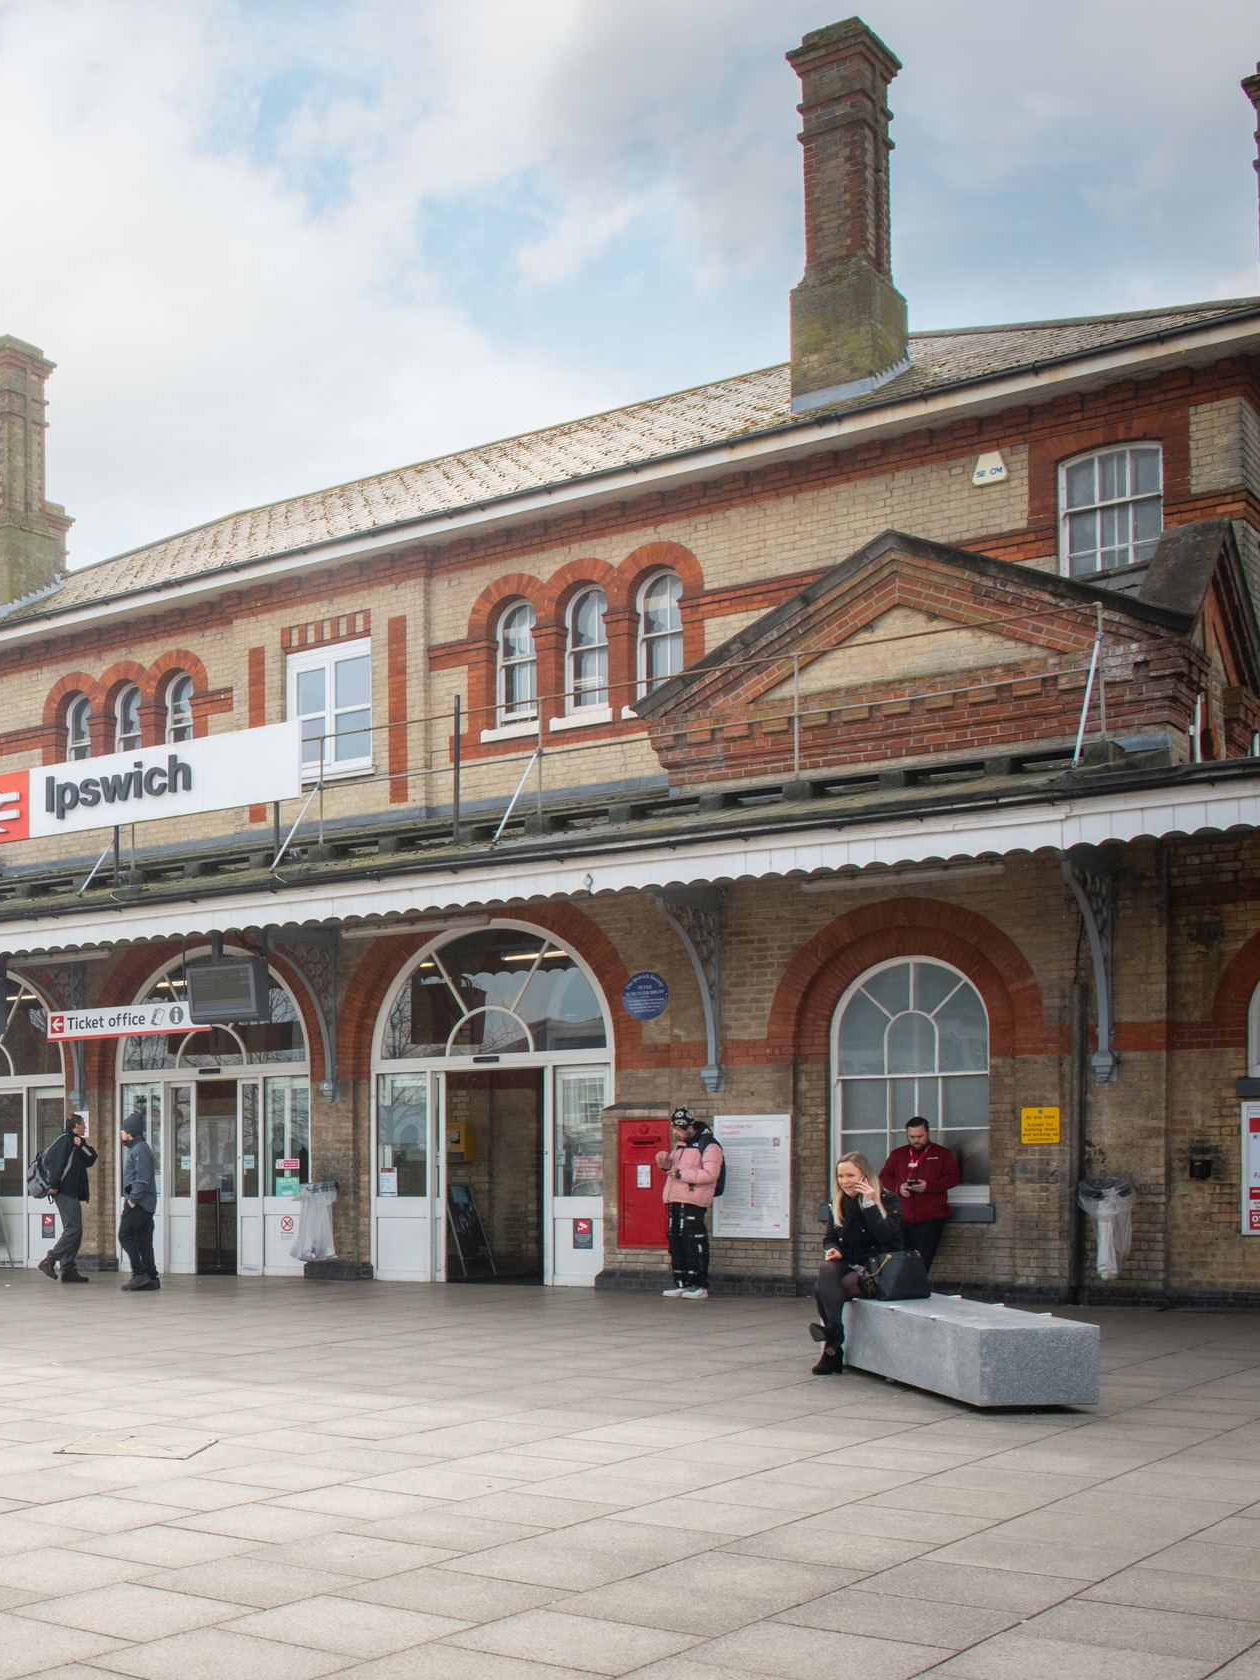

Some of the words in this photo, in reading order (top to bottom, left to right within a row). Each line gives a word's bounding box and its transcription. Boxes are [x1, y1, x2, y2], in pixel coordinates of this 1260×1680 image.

[976, 467, 1003, 478] SEOM
[45, 753, 193, 820] Ipswich
[67, 1015, 105, 1031] Ticket
[108, 1012, 146, 1027] office
